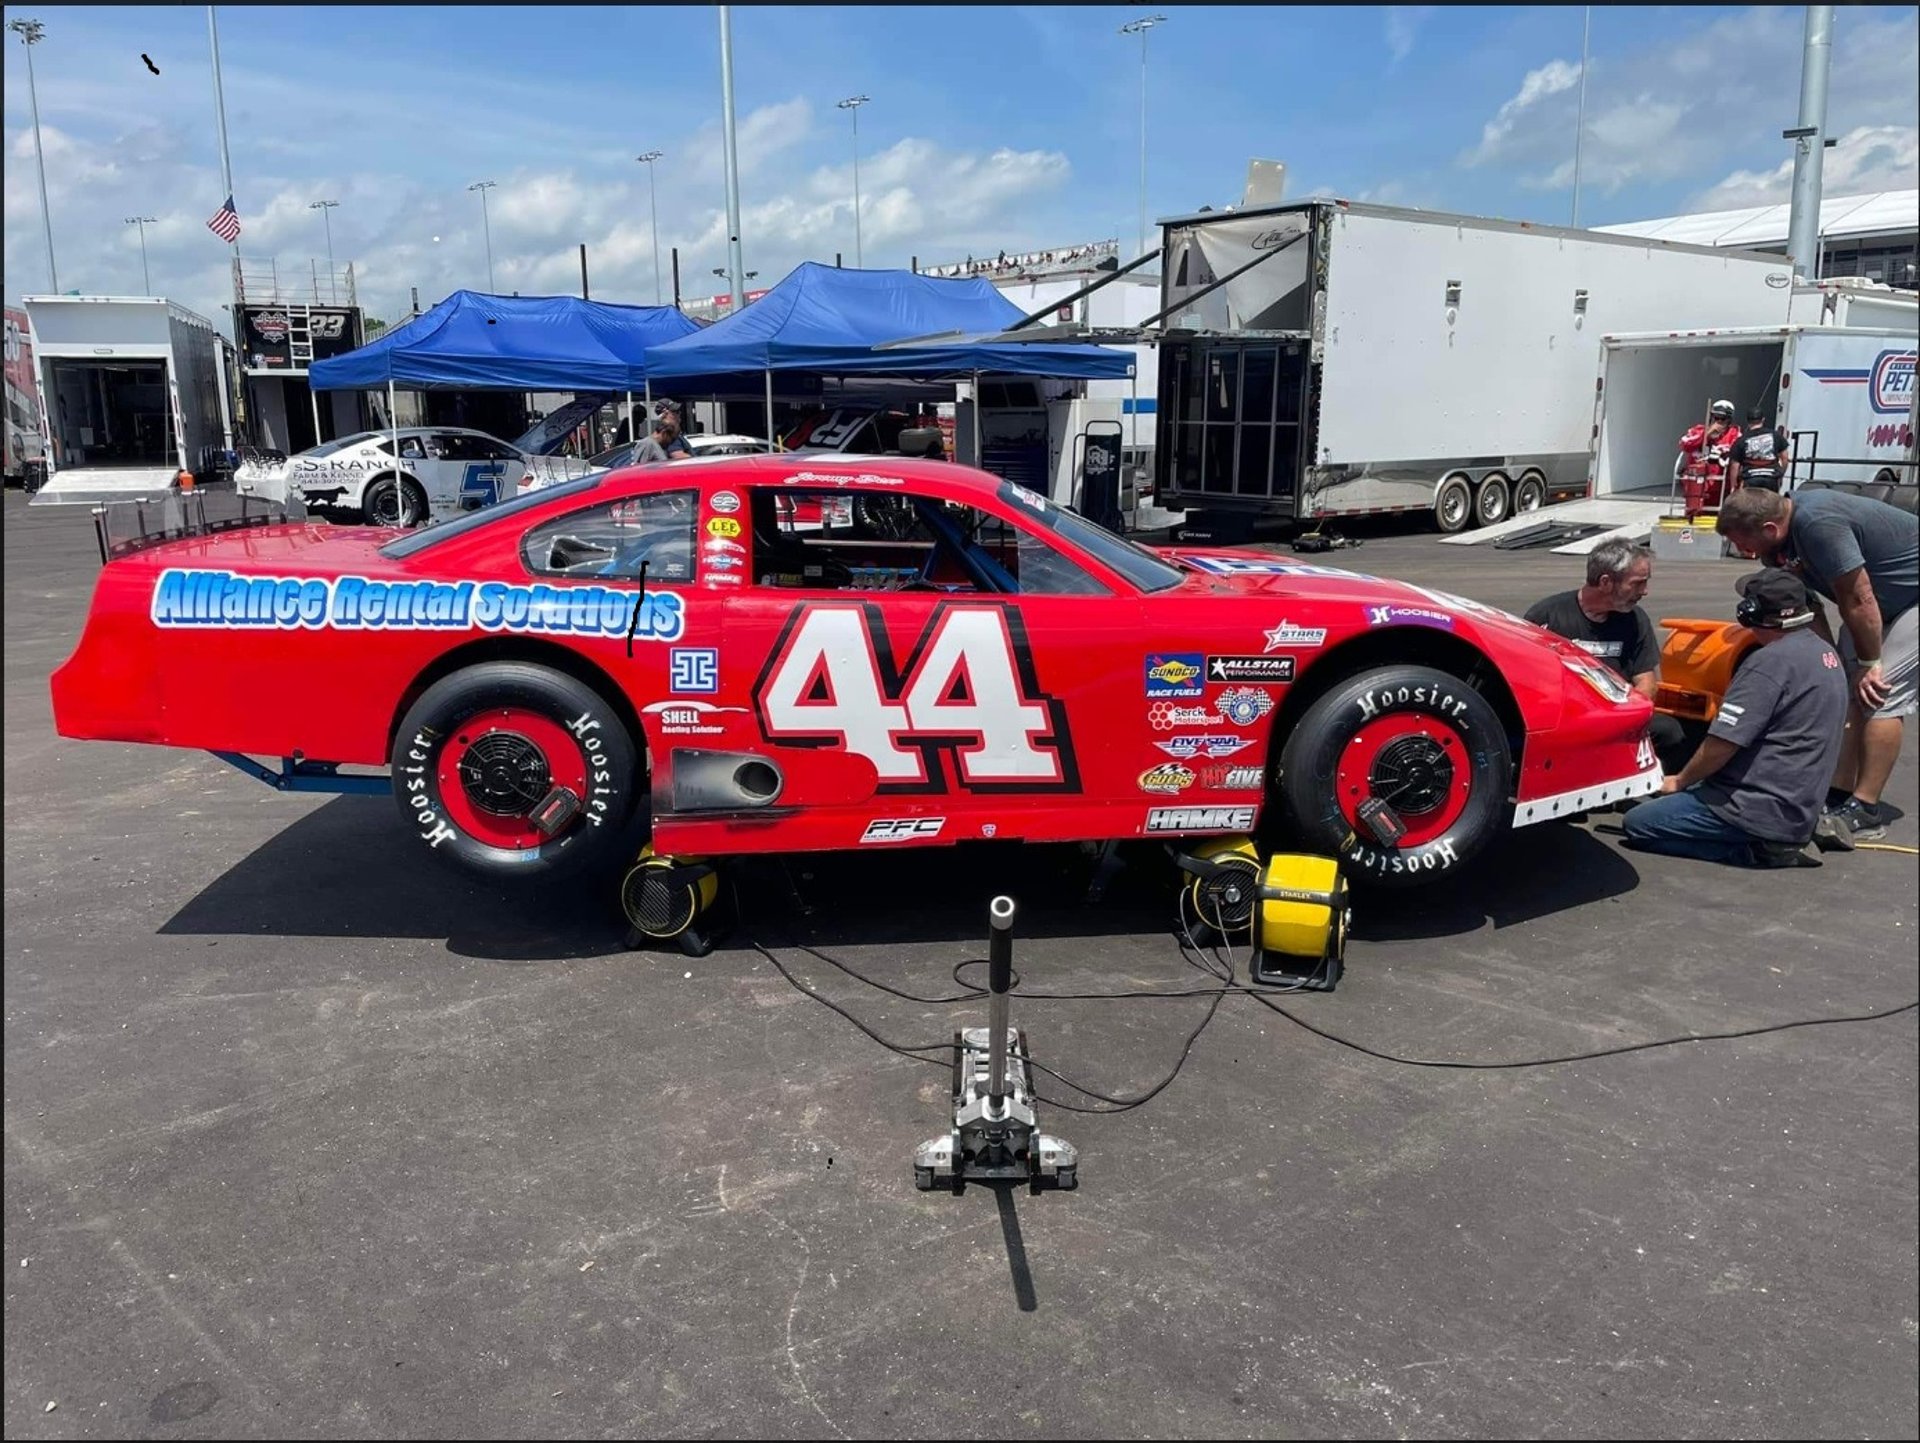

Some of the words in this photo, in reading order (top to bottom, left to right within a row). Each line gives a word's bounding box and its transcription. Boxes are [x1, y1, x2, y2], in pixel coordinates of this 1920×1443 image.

[308, 315, 345, 338] 33
[712, 521, 737, 533] LEE
[154, 570, 329, 626] Alliance
[331, 576, 477, 628] Rental
[474, 583, 683, 638] Solutions
[1391, 609, 1451, 622] HOOSIER
[1226, 660, 1291, 669] ALLSTAR
[1150, 667, 1198, 677] SUNOCO
[1225, 669, 1291, 677] PERFORMANCE
[753, 601, 1080, 793] 44
[1173, 688, 1202, 696] FUELS
[1357, 683, 1467, 722] Hoosier
[662, 711, 700, 723] SHELL
[1174, 708, 1204, 717] Serck
[565, 712, 618, 826] Hoosier
[400, 734, 457, 848] Hoosier
[1149, 808, 1253, 830] HAMKE
[866, 819, 943, 834] PFC
[1351, 837, 1458, 877] Hoosier
[1280, 890, 1310, 899] STANLEY
